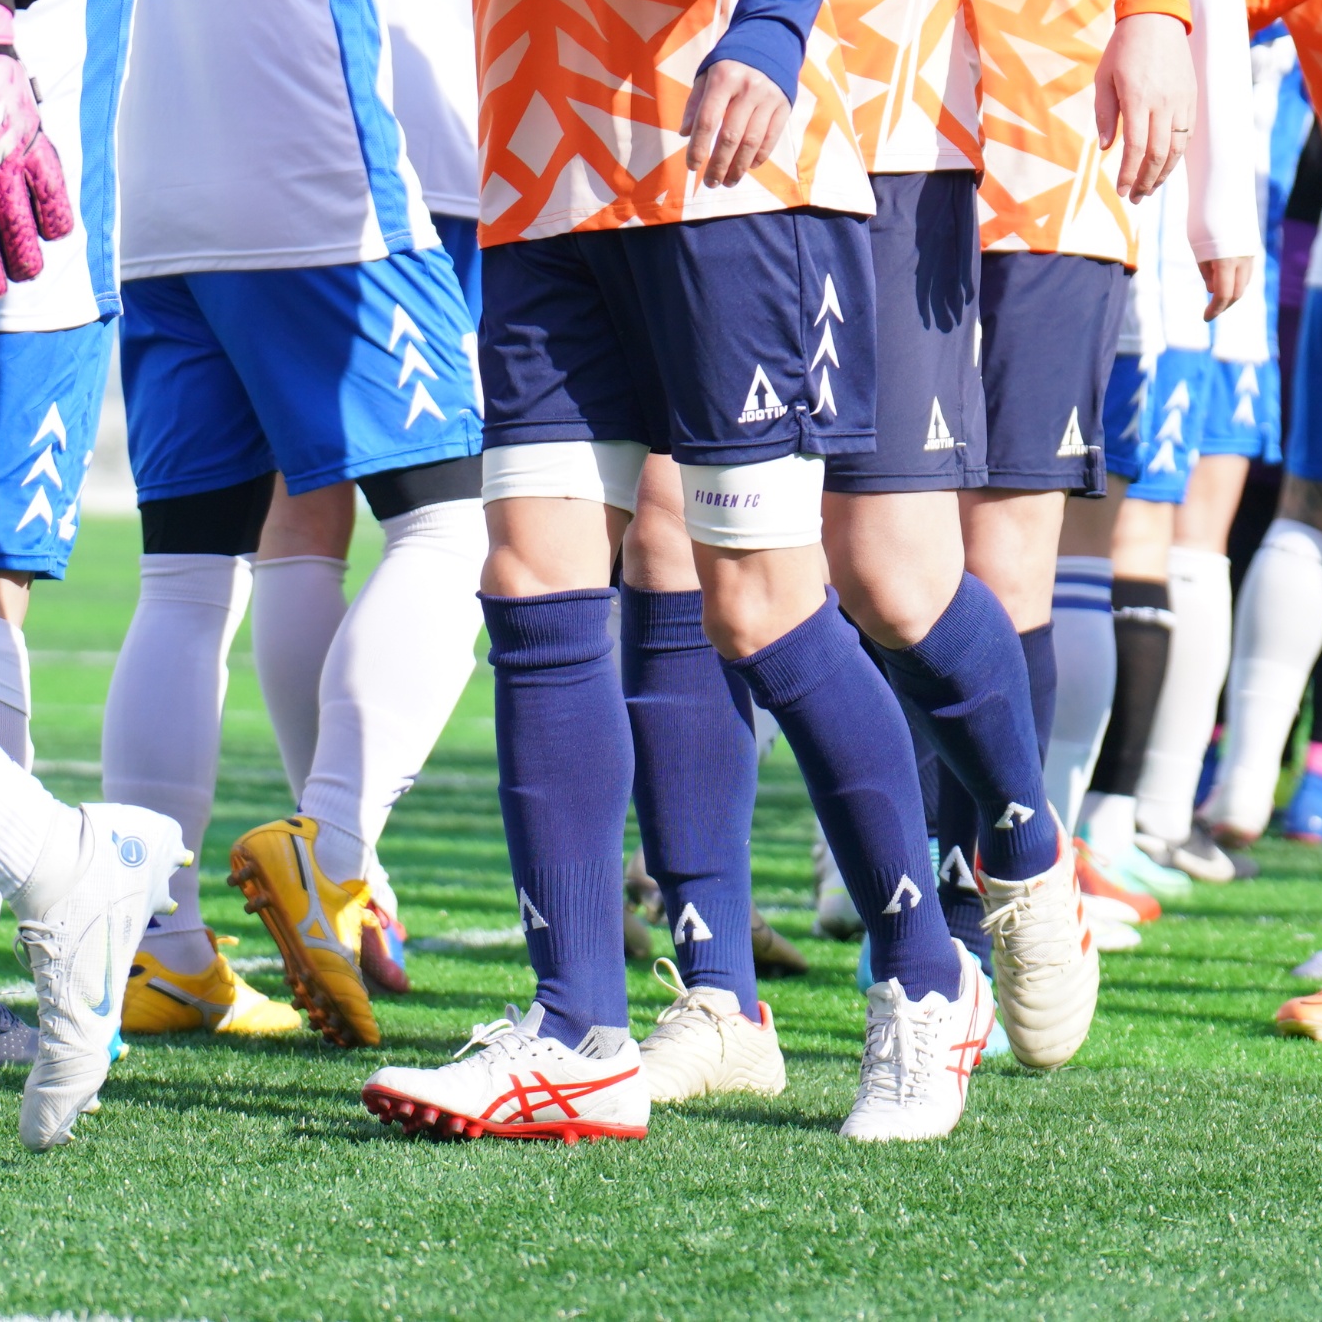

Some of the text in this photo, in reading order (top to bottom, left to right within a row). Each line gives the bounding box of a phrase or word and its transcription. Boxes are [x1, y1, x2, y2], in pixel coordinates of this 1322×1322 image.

[737, 404, 789, 424] JOOTIN
[695, 489, 761, 508] FIOREN FC
